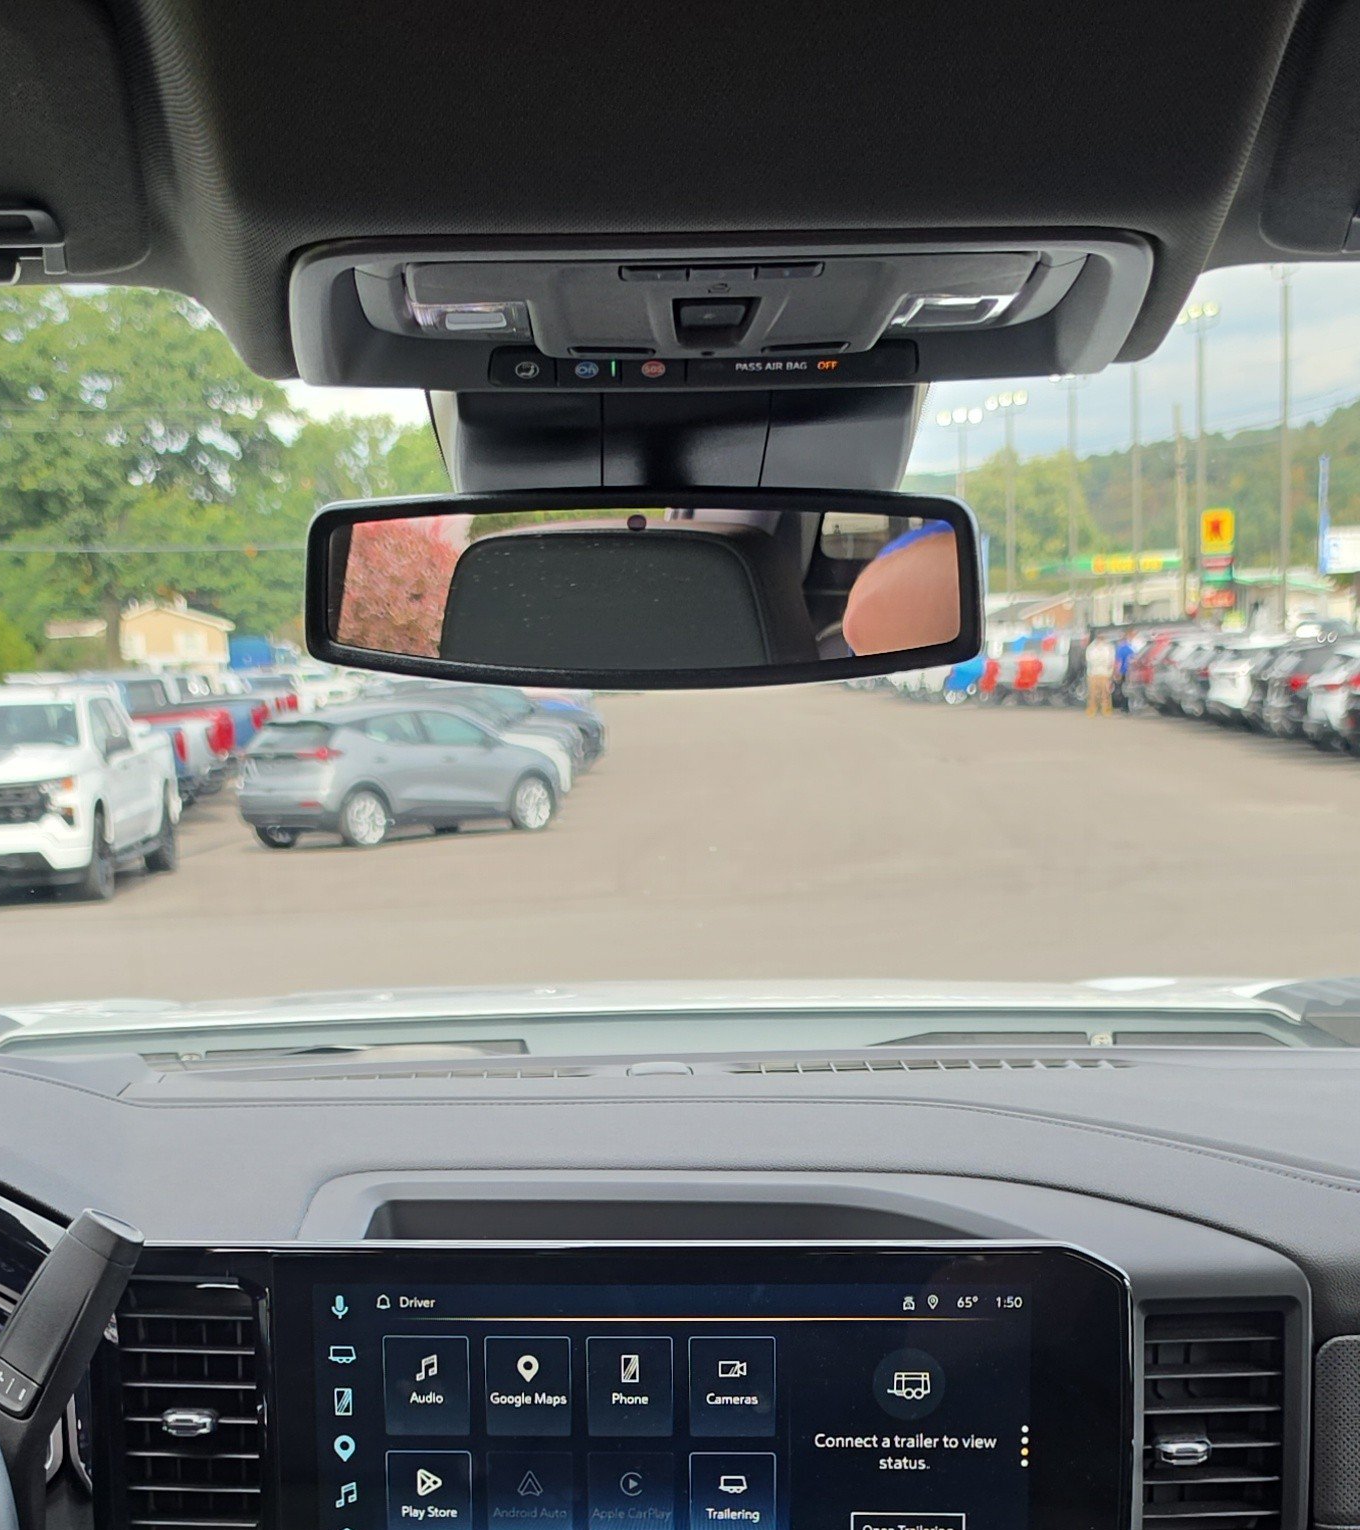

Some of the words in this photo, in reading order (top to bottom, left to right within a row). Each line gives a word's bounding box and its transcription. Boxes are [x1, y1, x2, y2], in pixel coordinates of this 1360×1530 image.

[735, 362, 762, 373] PASS
[765, 362, 784, 371] AIR
[787, 361, 808, 371] BAG
[817, 360, 838, 371] OFF
[399, 1296, 436, 1310] Driver
[957, 1296, 978, 1309] 65°
[996, 1296, 1023, 1309] 1:50
[410, 1391, 444, 1405] Audio
[490, 1392, 532, 1408] Google
[534, 1392, 568, 1408] Maps
[612, 1392, 649, 1405] Phone
[706, 1393, 759, 1406] Cameras
[815, 1434, 878, 1450] Connect
[880, 1438, 889, 1450] a
[893, 1434, 939, 1450] trailer
[942, 1436, 955, 1450] to
[960, 1435, 998, 1450] view
[879, 1455, 930, 1471] status.
[401, 1505, 425, 1521] Play
[427, 1505, 459, 1519] Store
[492, 1506, 538, 1520] Android
[540, 1506, 568, 1520] Auto
[592, 1506, 625, 1522] Apple
[627, 1506, 672, 1522] CarPlay
[706, 1507, 761, 1524] Trailering
